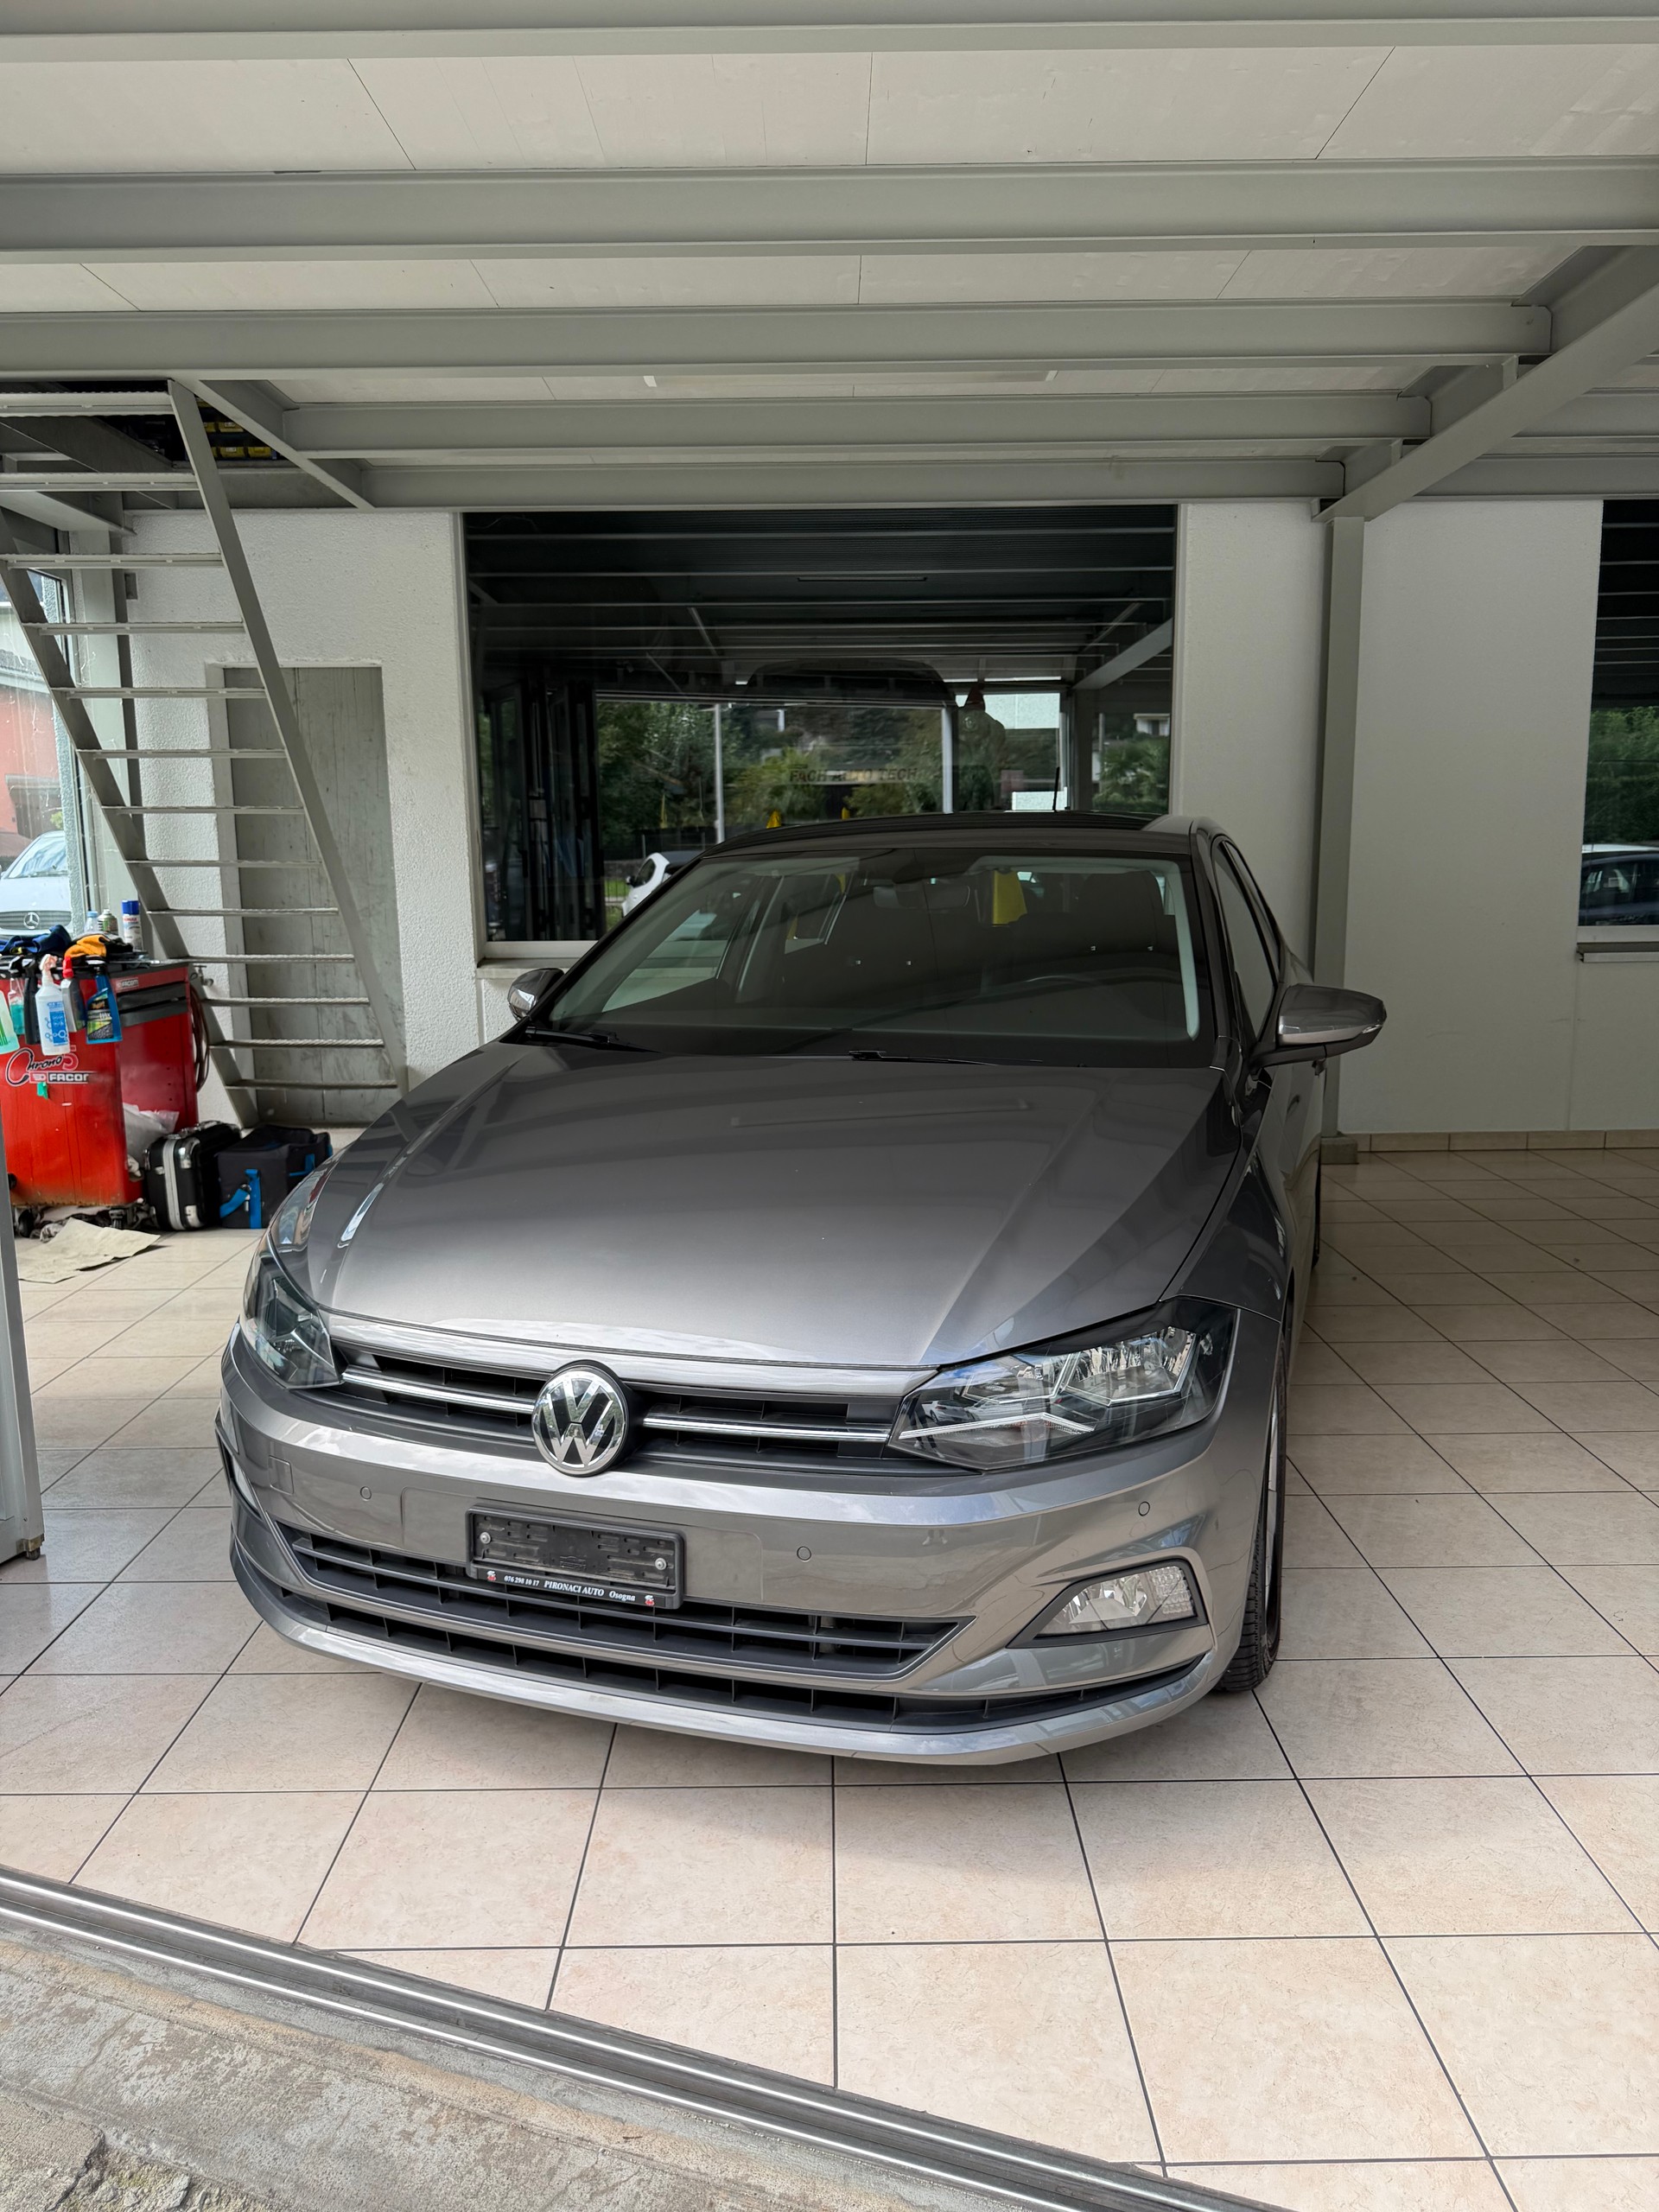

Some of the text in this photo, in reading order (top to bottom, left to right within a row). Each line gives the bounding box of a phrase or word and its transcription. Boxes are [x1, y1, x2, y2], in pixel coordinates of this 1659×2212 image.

[543, 1580, 582, 1593] PIRONACI
[582, 1586, 605, 1597] AUTO
[608, 1590, 636, 1602] Osogna
